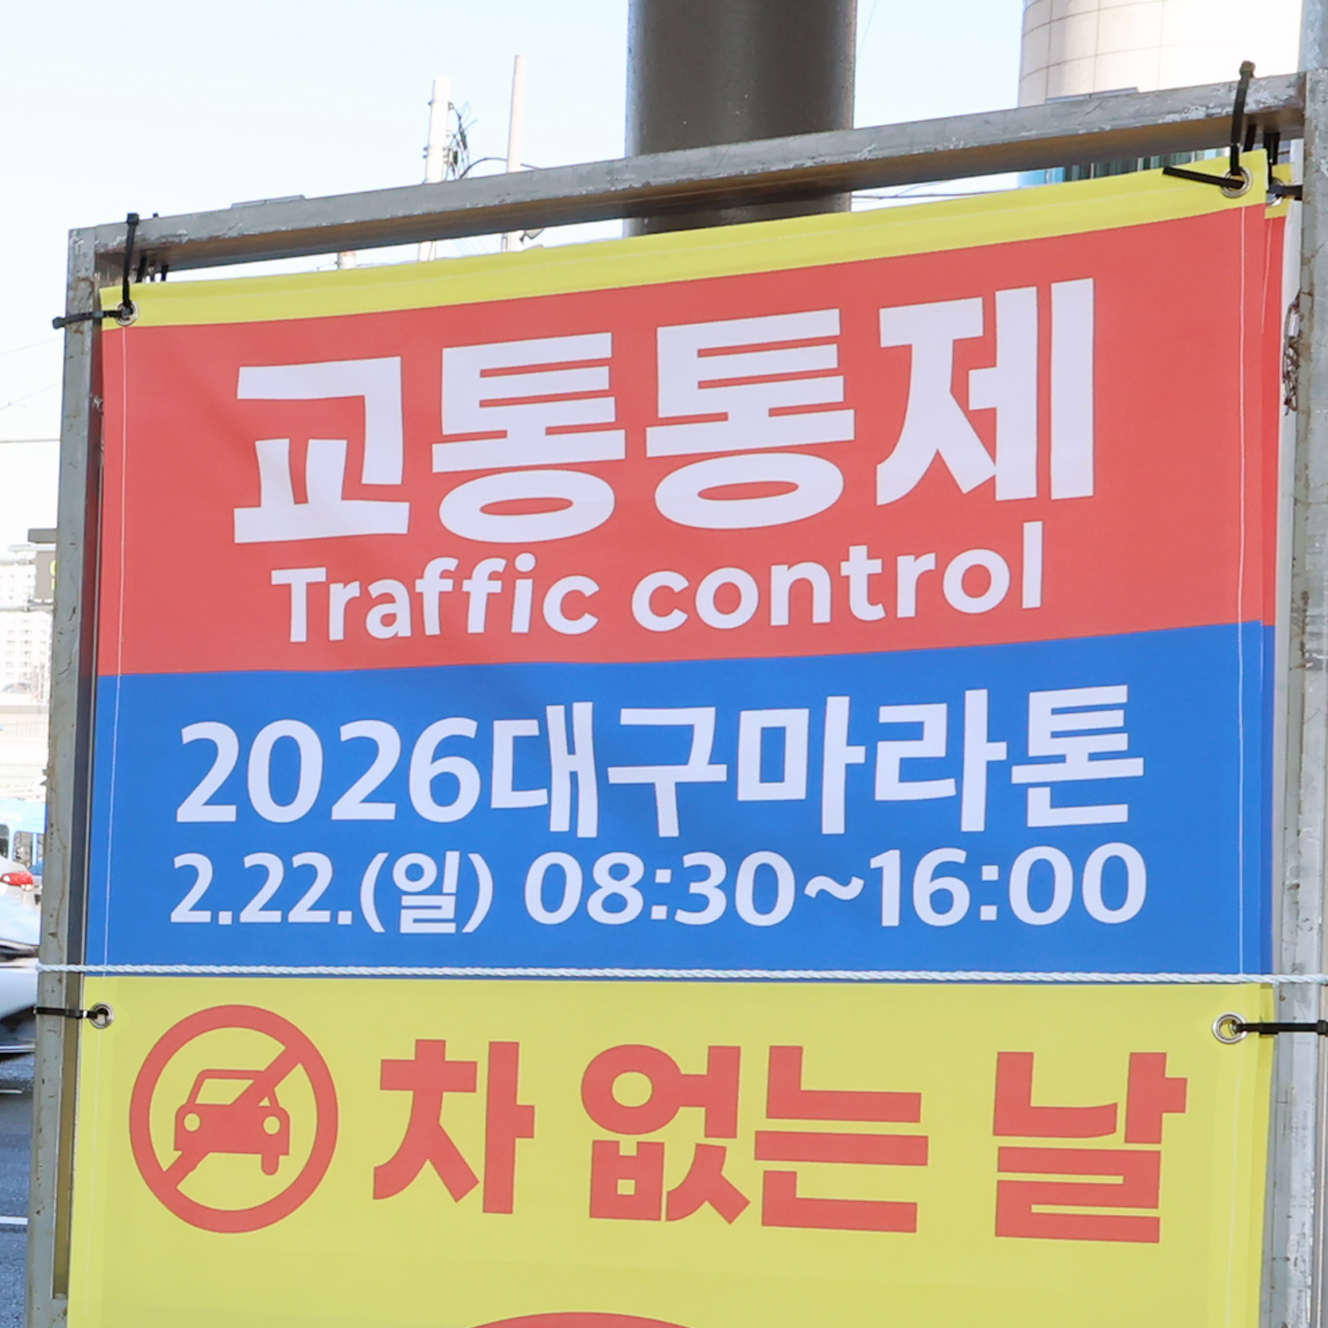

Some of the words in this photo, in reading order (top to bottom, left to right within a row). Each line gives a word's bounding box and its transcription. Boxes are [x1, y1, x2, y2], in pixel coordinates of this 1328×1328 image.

[234, 278, 1096, 544] 교통통제
[271, 552, 599, 643] Traffic
[631, 521, 1044, 630] control
[176, 685, 1145, 839] 2026대구마라톤
[171, 850, 493, 936] 2.22.(일)
[524, 842, 1147, 930] 08:30~16:00
[372, 1039, 536, 1214] 차
[580, 1044, 929, 1234] 없는
[992, 1052, 1187, 1244] 날
